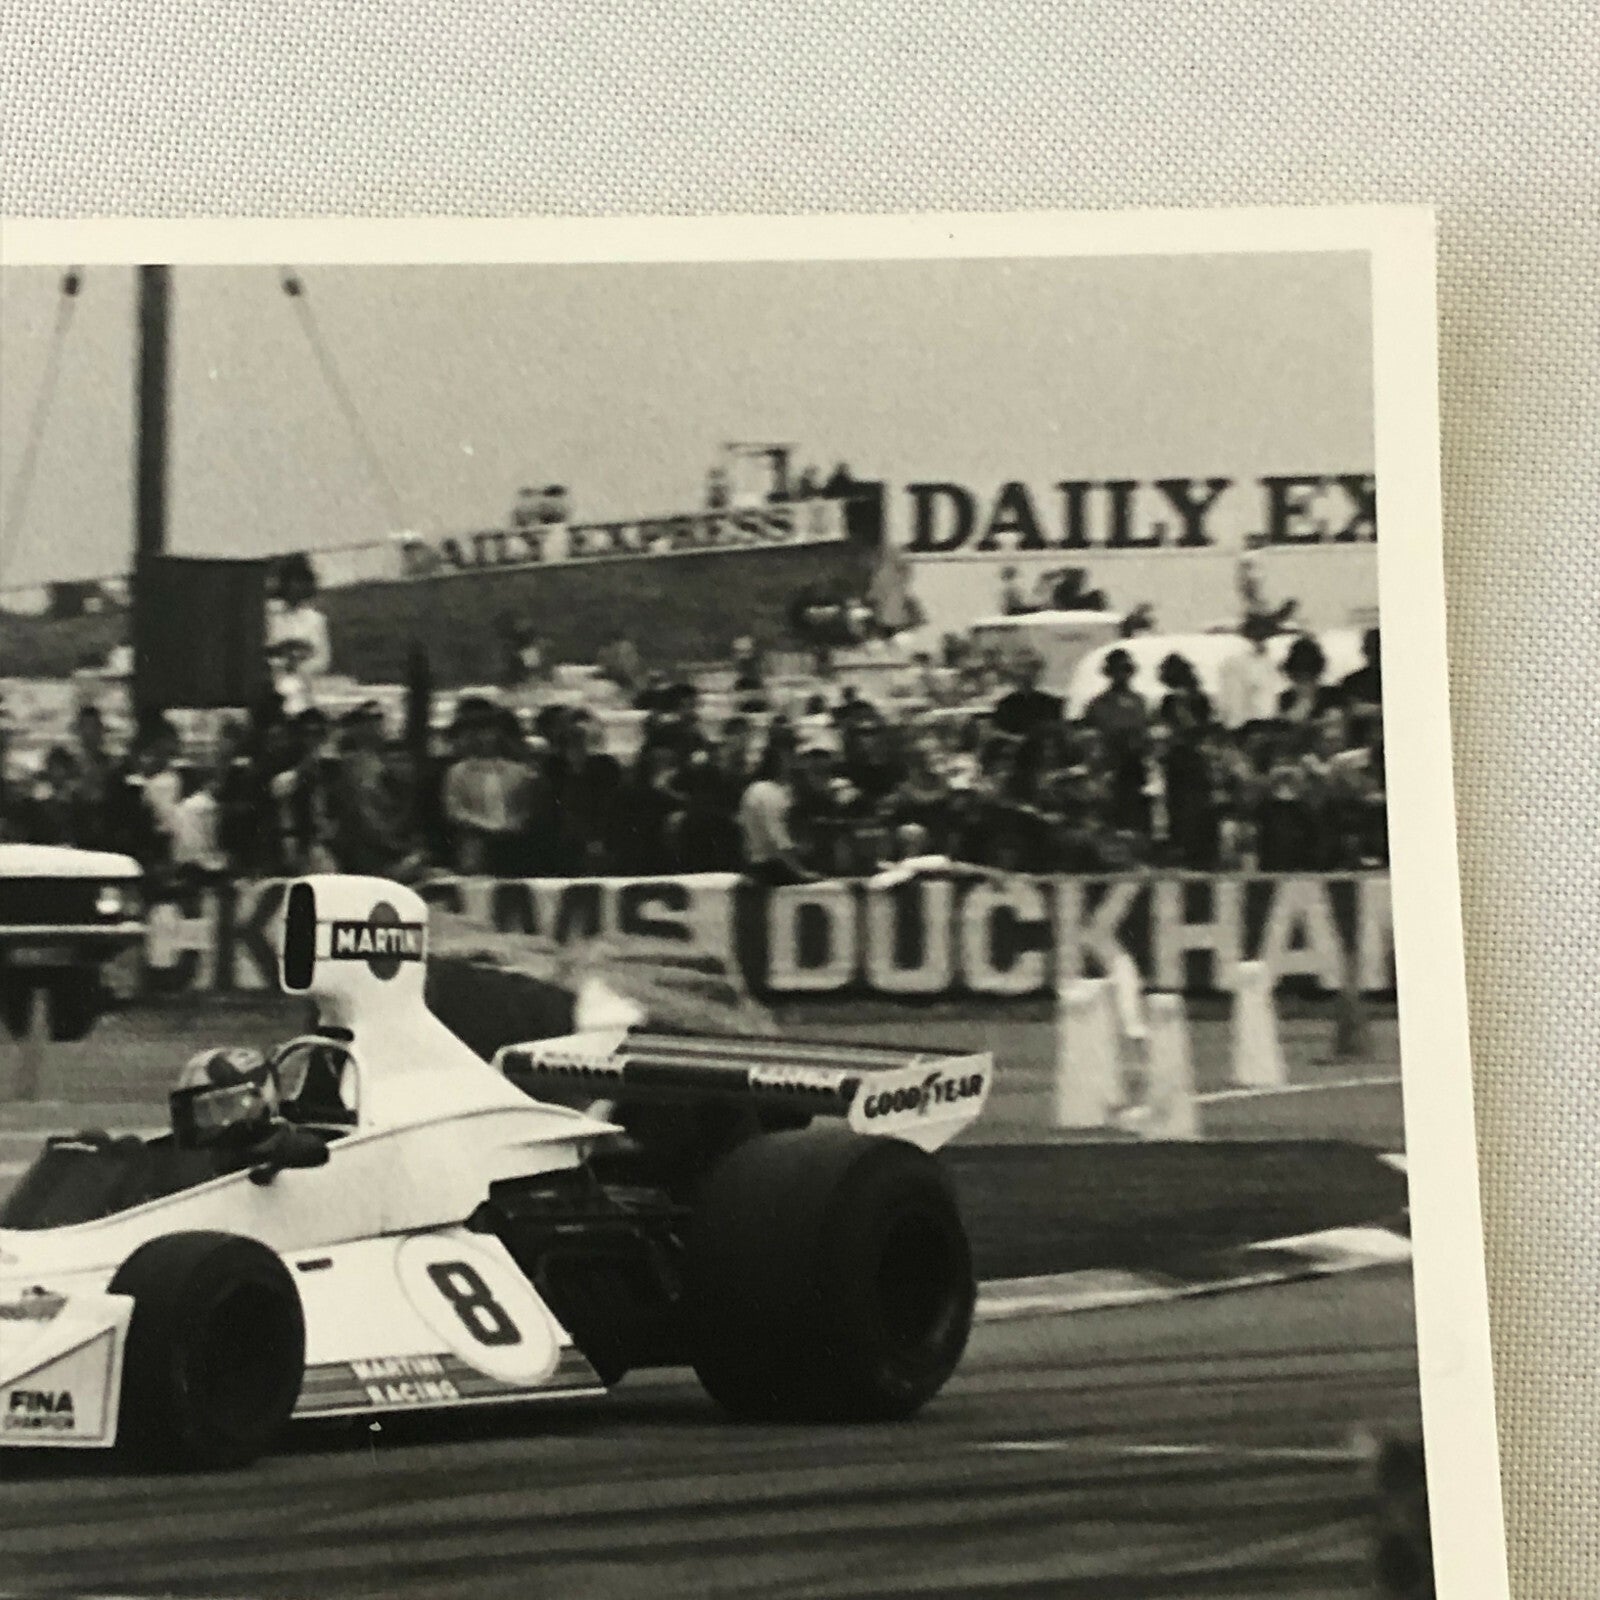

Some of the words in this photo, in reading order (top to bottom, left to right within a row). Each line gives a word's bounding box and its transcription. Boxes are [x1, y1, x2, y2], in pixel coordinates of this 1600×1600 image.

[903, 478, 1233, 552] DAILY
[427, 1261, 521, 1347] 8
[10, 1391, 73, 1413] FINA
